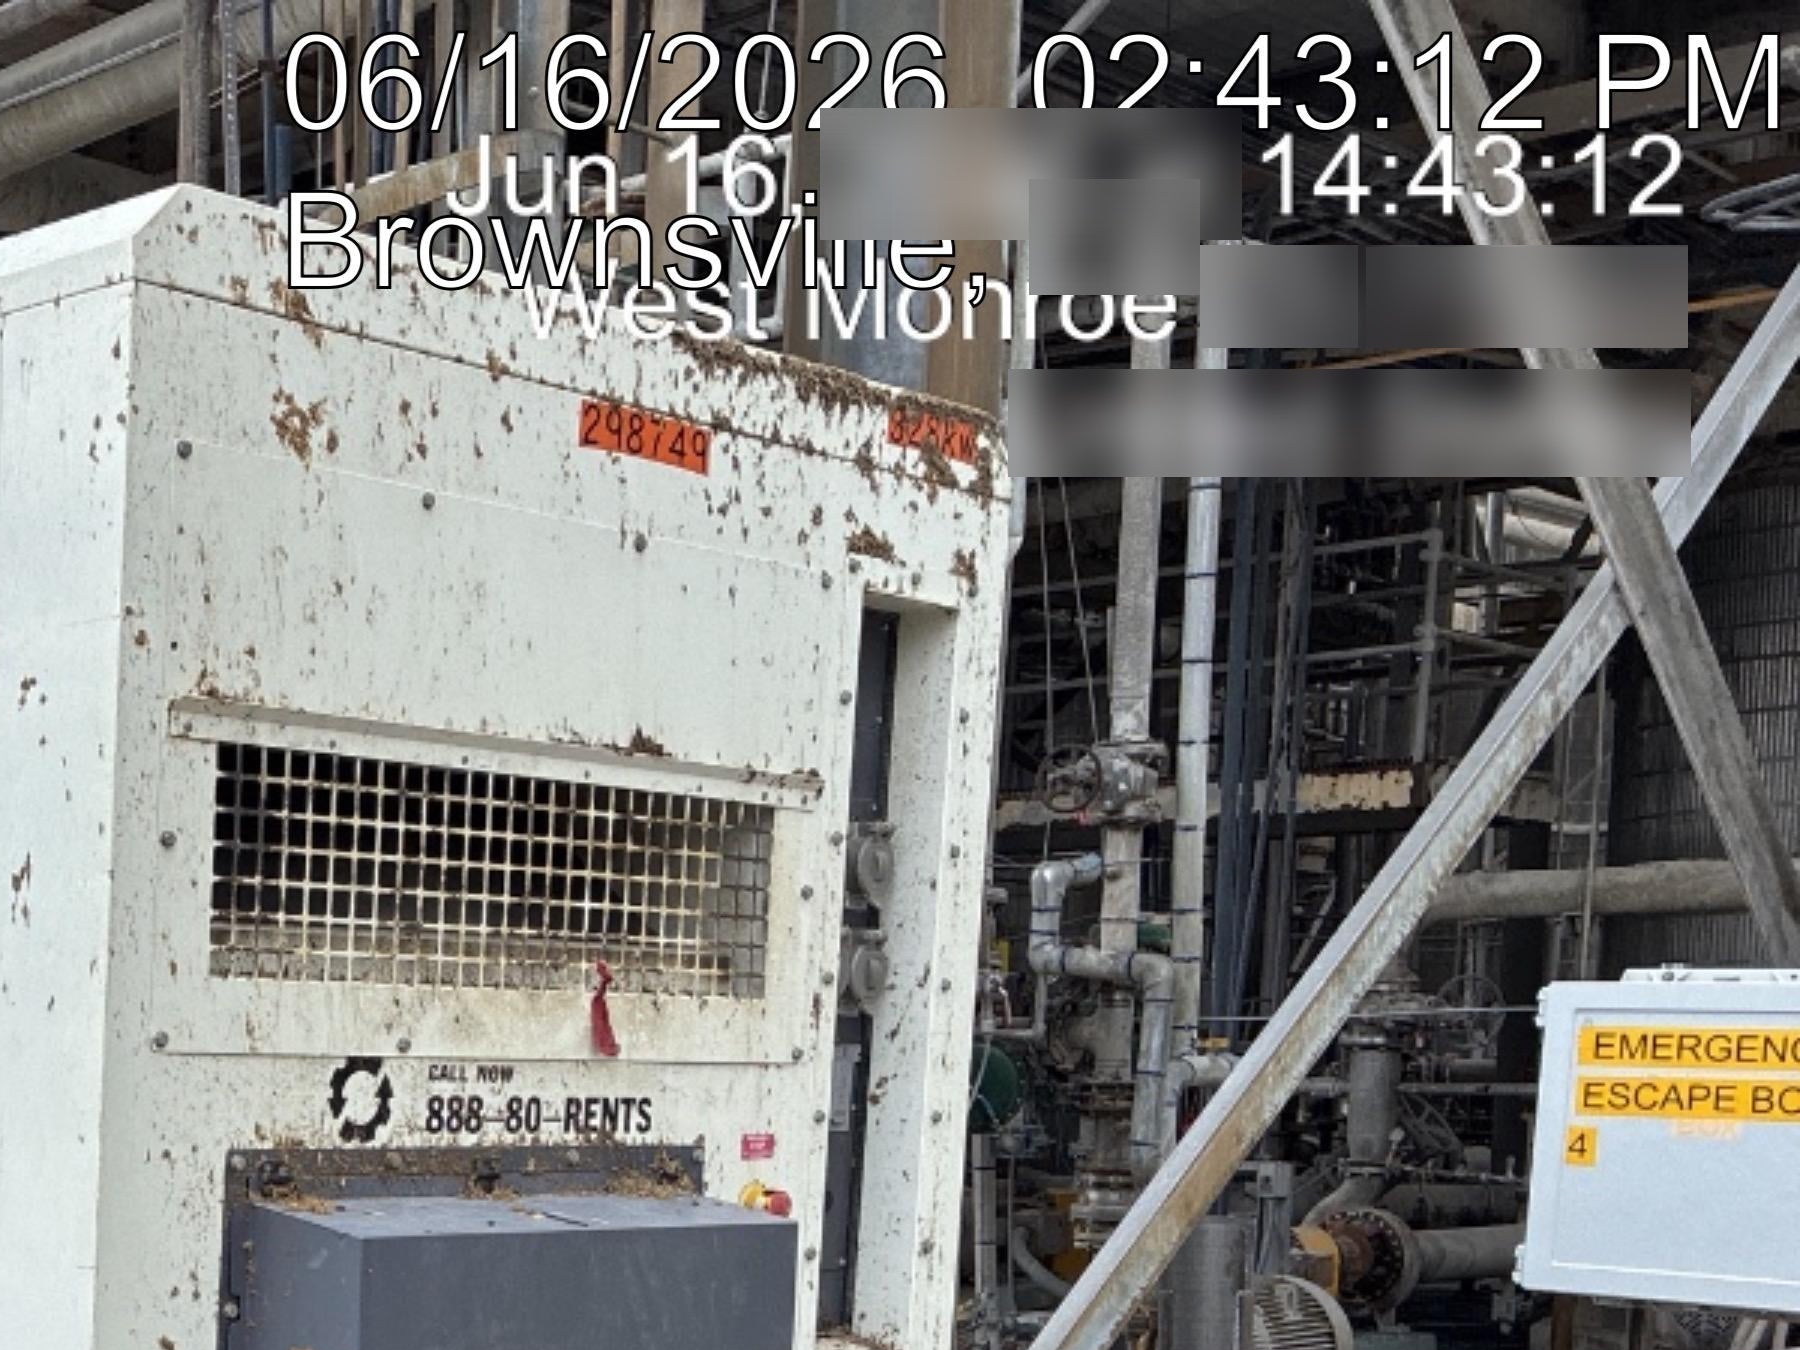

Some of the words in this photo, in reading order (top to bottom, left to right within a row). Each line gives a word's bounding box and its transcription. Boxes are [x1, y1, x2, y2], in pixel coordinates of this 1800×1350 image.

[582, 401, 709, 474] 298749
[428, 1064, 468, 1082] CALL
[476, 1065, 515, 1083] NOW
[1582, 1082, 1738, 1113] ESCAPE
[425, 1095, 653, 1135] 888-80-RENTS
[1567, 1132, 1588, 1159] 4
